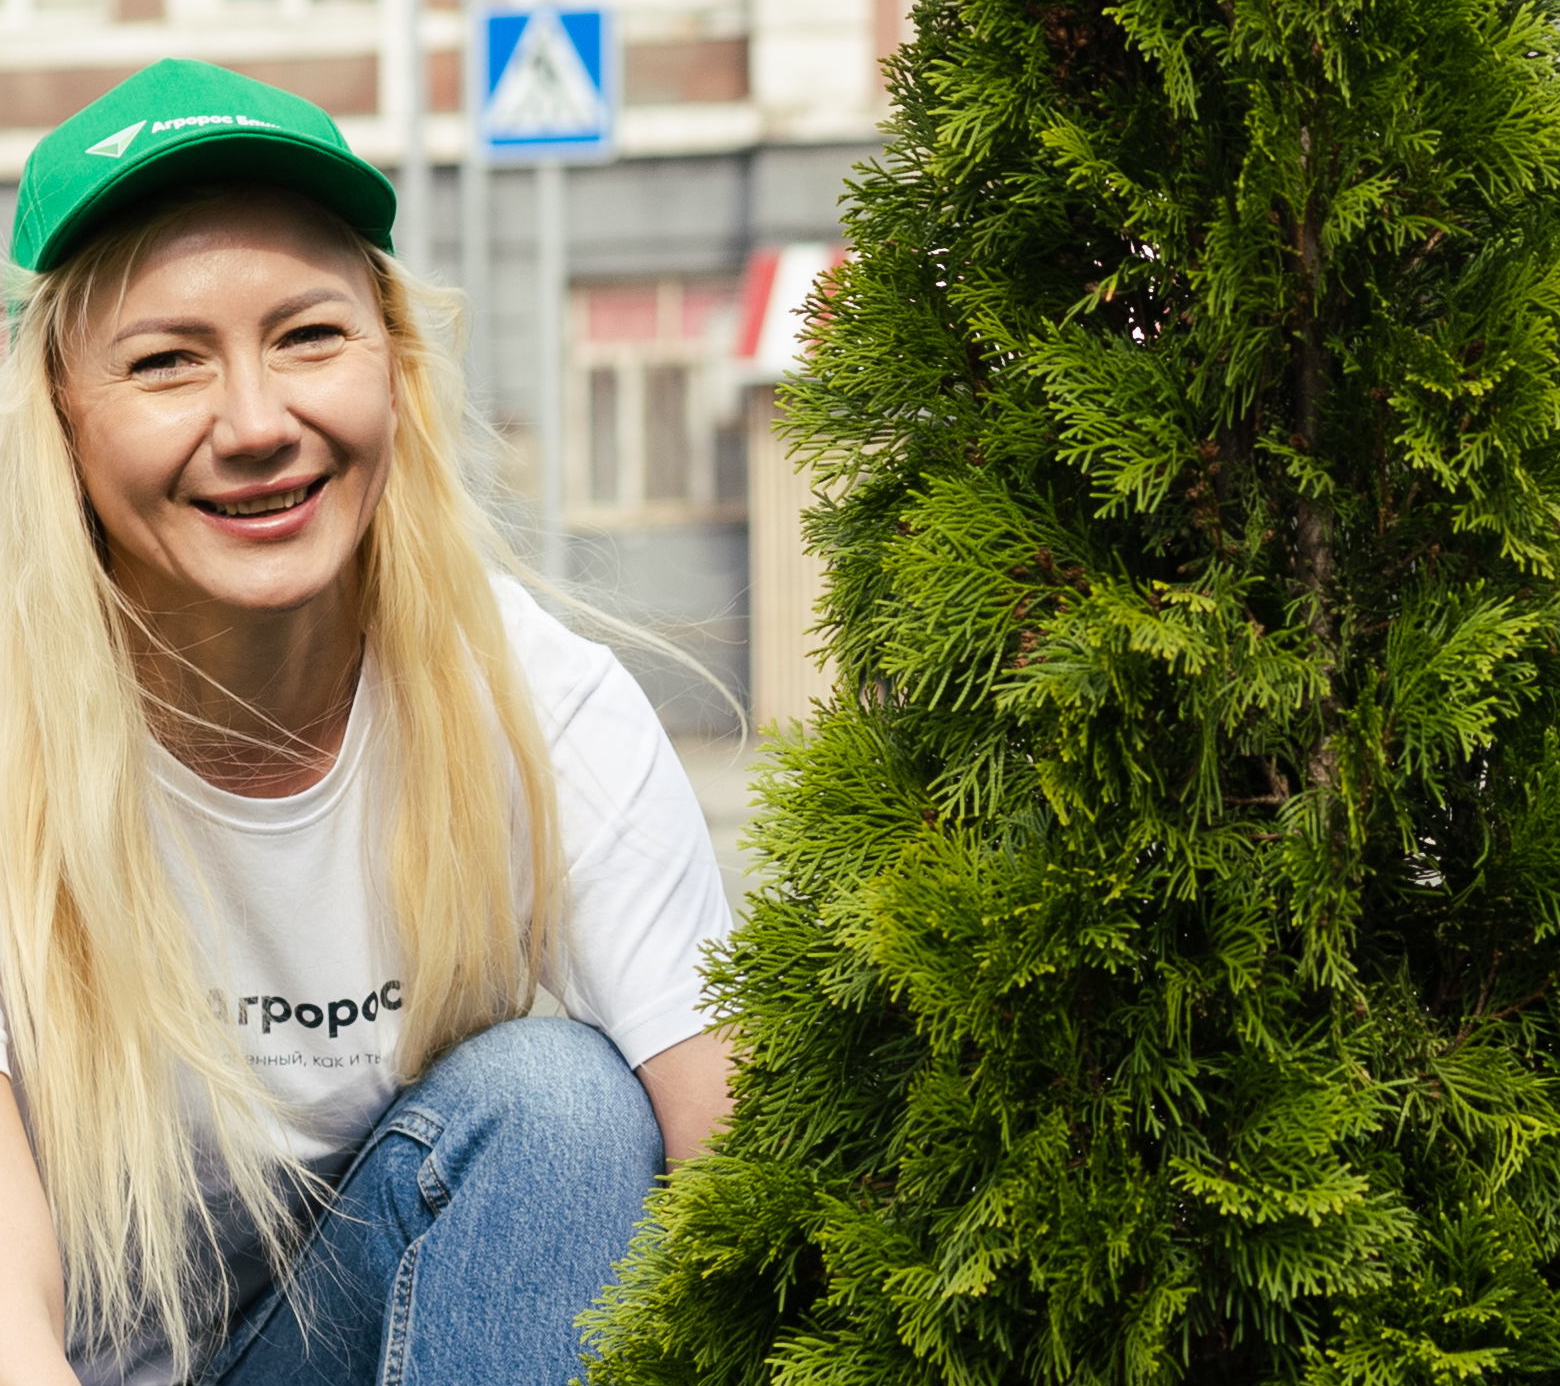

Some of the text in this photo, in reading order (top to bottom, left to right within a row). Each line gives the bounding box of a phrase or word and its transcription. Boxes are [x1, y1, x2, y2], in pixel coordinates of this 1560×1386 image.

[151, 115, 234, 134] Агророс
[313, 1055, 343, 1068] как
[349, 1053, 360, 1065] и
